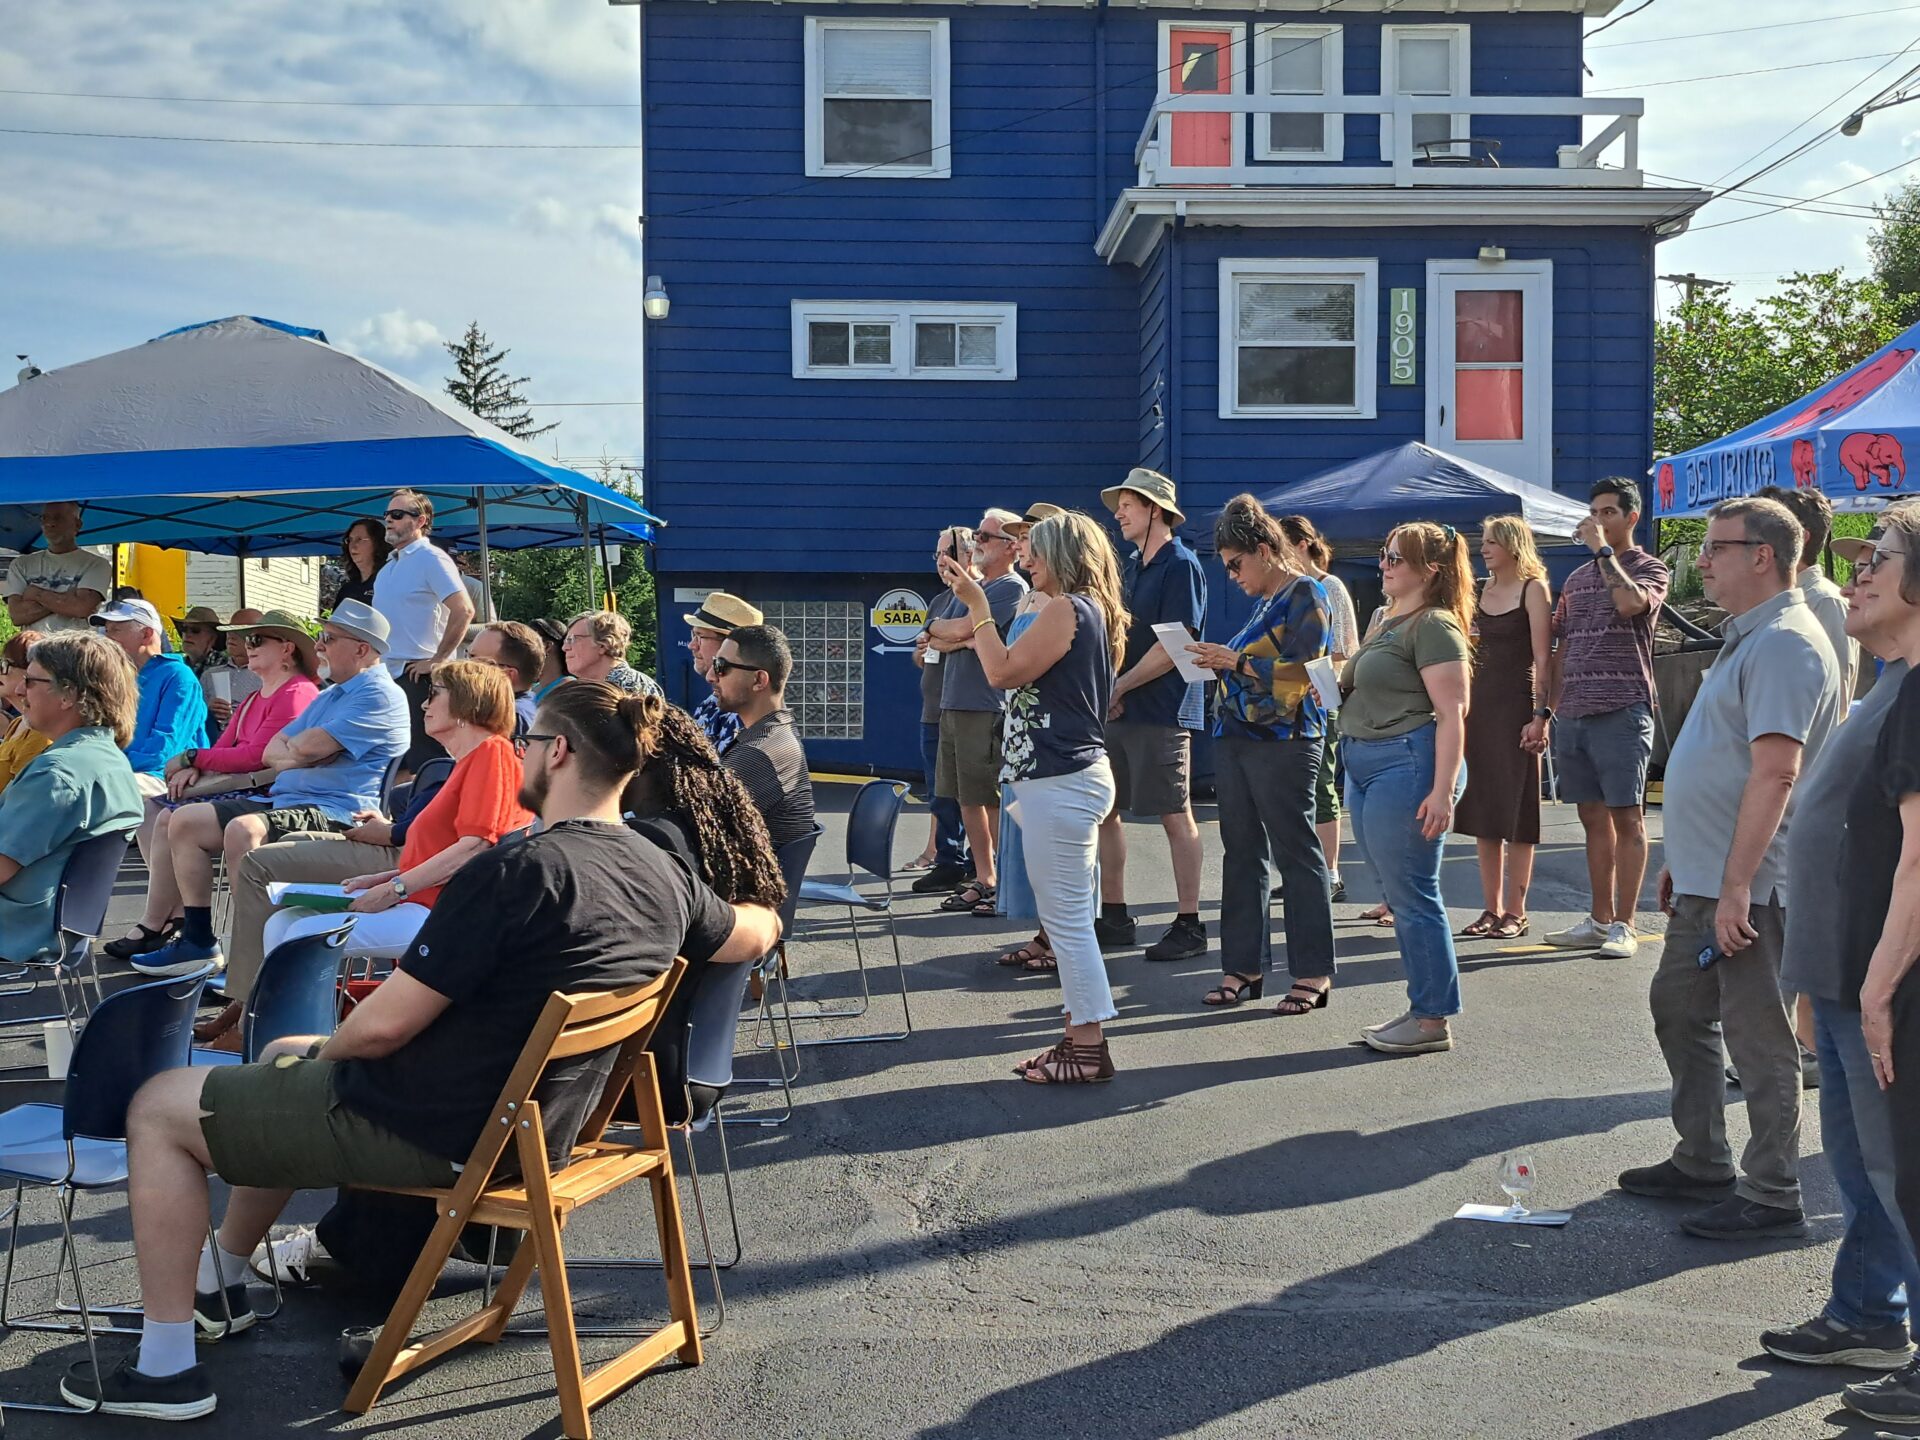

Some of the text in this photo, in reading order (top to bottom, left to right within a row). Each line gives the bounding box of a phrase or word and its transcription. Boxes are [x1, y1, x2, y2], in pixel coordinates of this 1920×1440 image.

[1391, 291, 1414, 379] 1905
[1686, 443, 1777, 508] DELIRIUM
[883, 612, 922, 624] SABA
